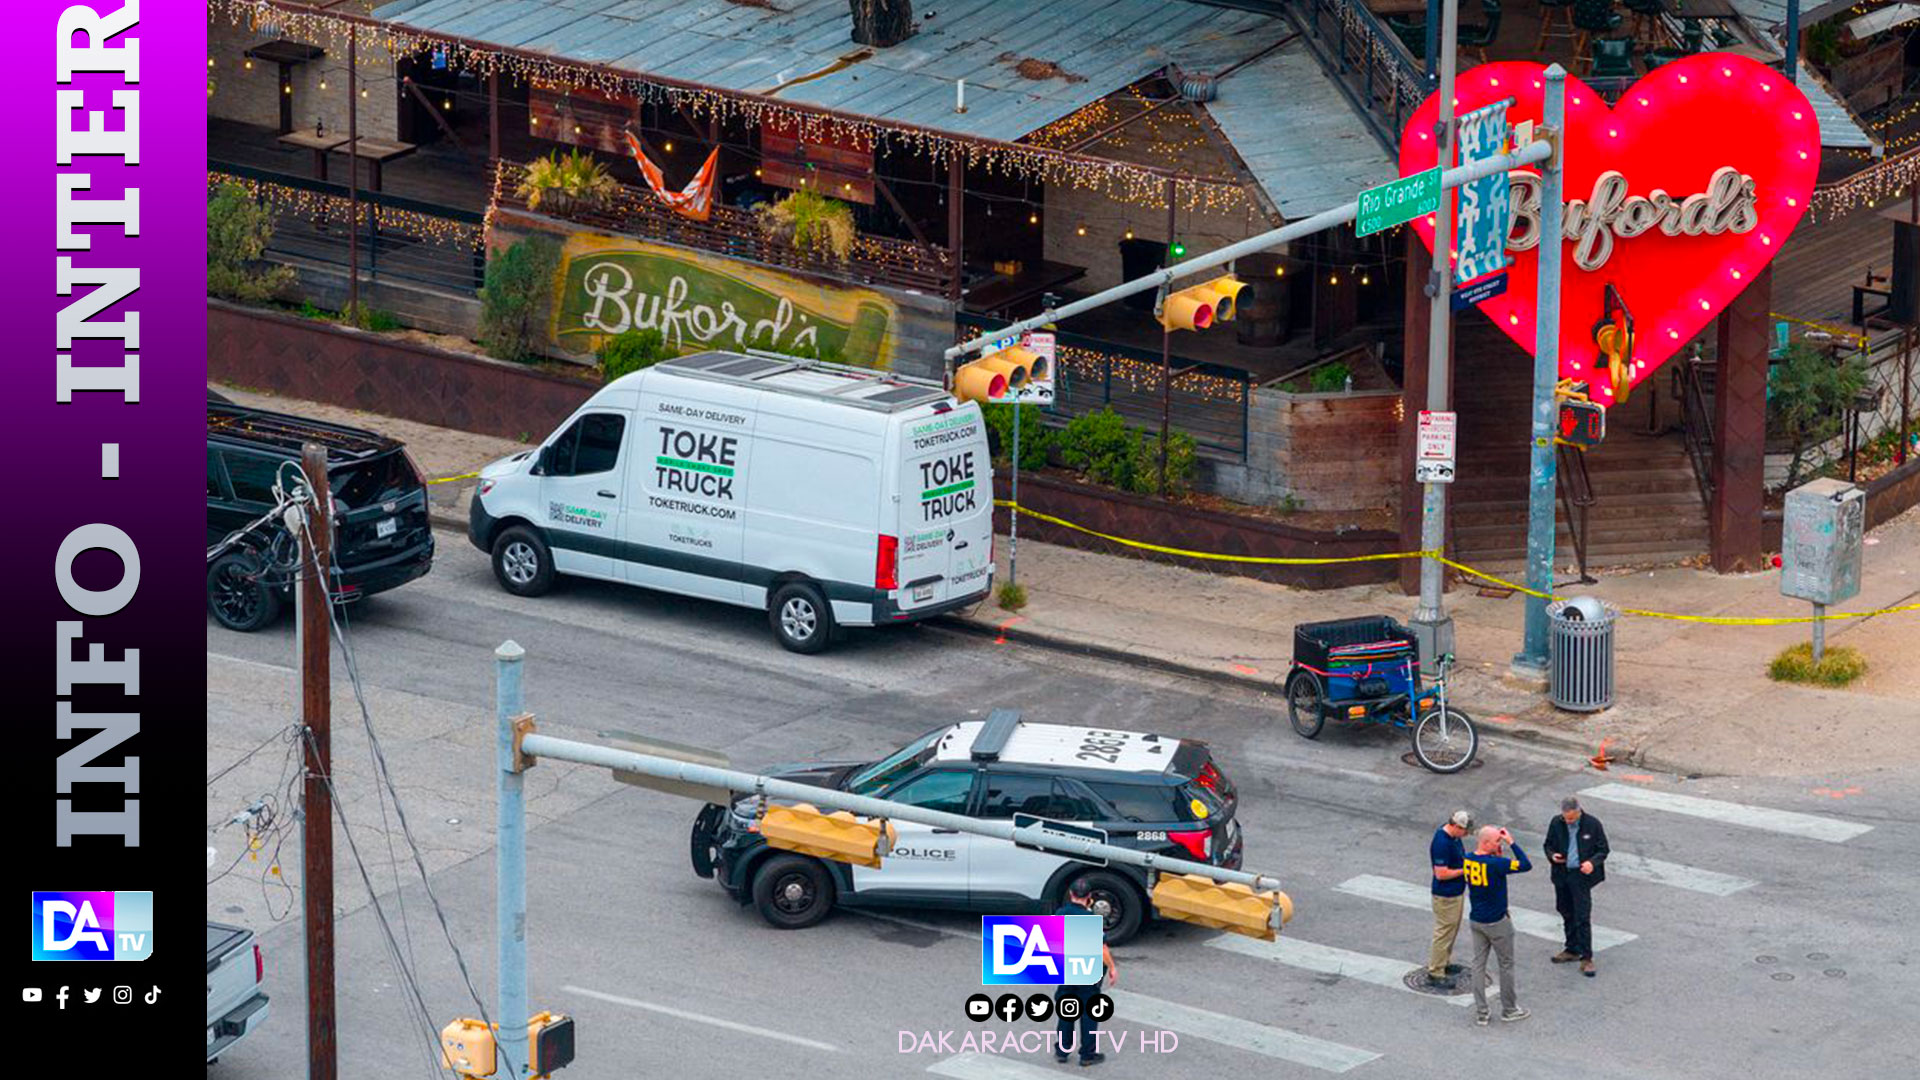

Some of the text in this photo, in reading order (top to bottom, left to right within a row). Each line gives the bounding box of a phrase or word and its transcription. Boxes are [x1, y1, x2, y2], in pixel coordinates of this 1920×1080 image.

[1362, 193, 1380, 215] Rio
[1385, 176, 1424, 207] Grande
[1507, 166, 1757, 271] Buford's
[584, 262, 818, 350] Buford's
[658, 403, 746, 425] SAME-DAY DELIVERY
[660, 427, 738, 466] TOKE
[914, 425, 976, 450] TOKETRUCK.COM
[656, 466, 733, 500] TRUCK
[920, 451, 974, 489] TOKE
[648, 496, 737, 520] TOKETRUCK.COM
[921, 489, 976, 521] TRUCK
[565, 514, 603, 528] DELIVERY
[669, 534, 713, 548] TOKETRUCKS
[1137, 831, 1167, 841] 2868
[889, 847, 956, 859] OLICE
[1463, 859, 1488, 887] FBI
